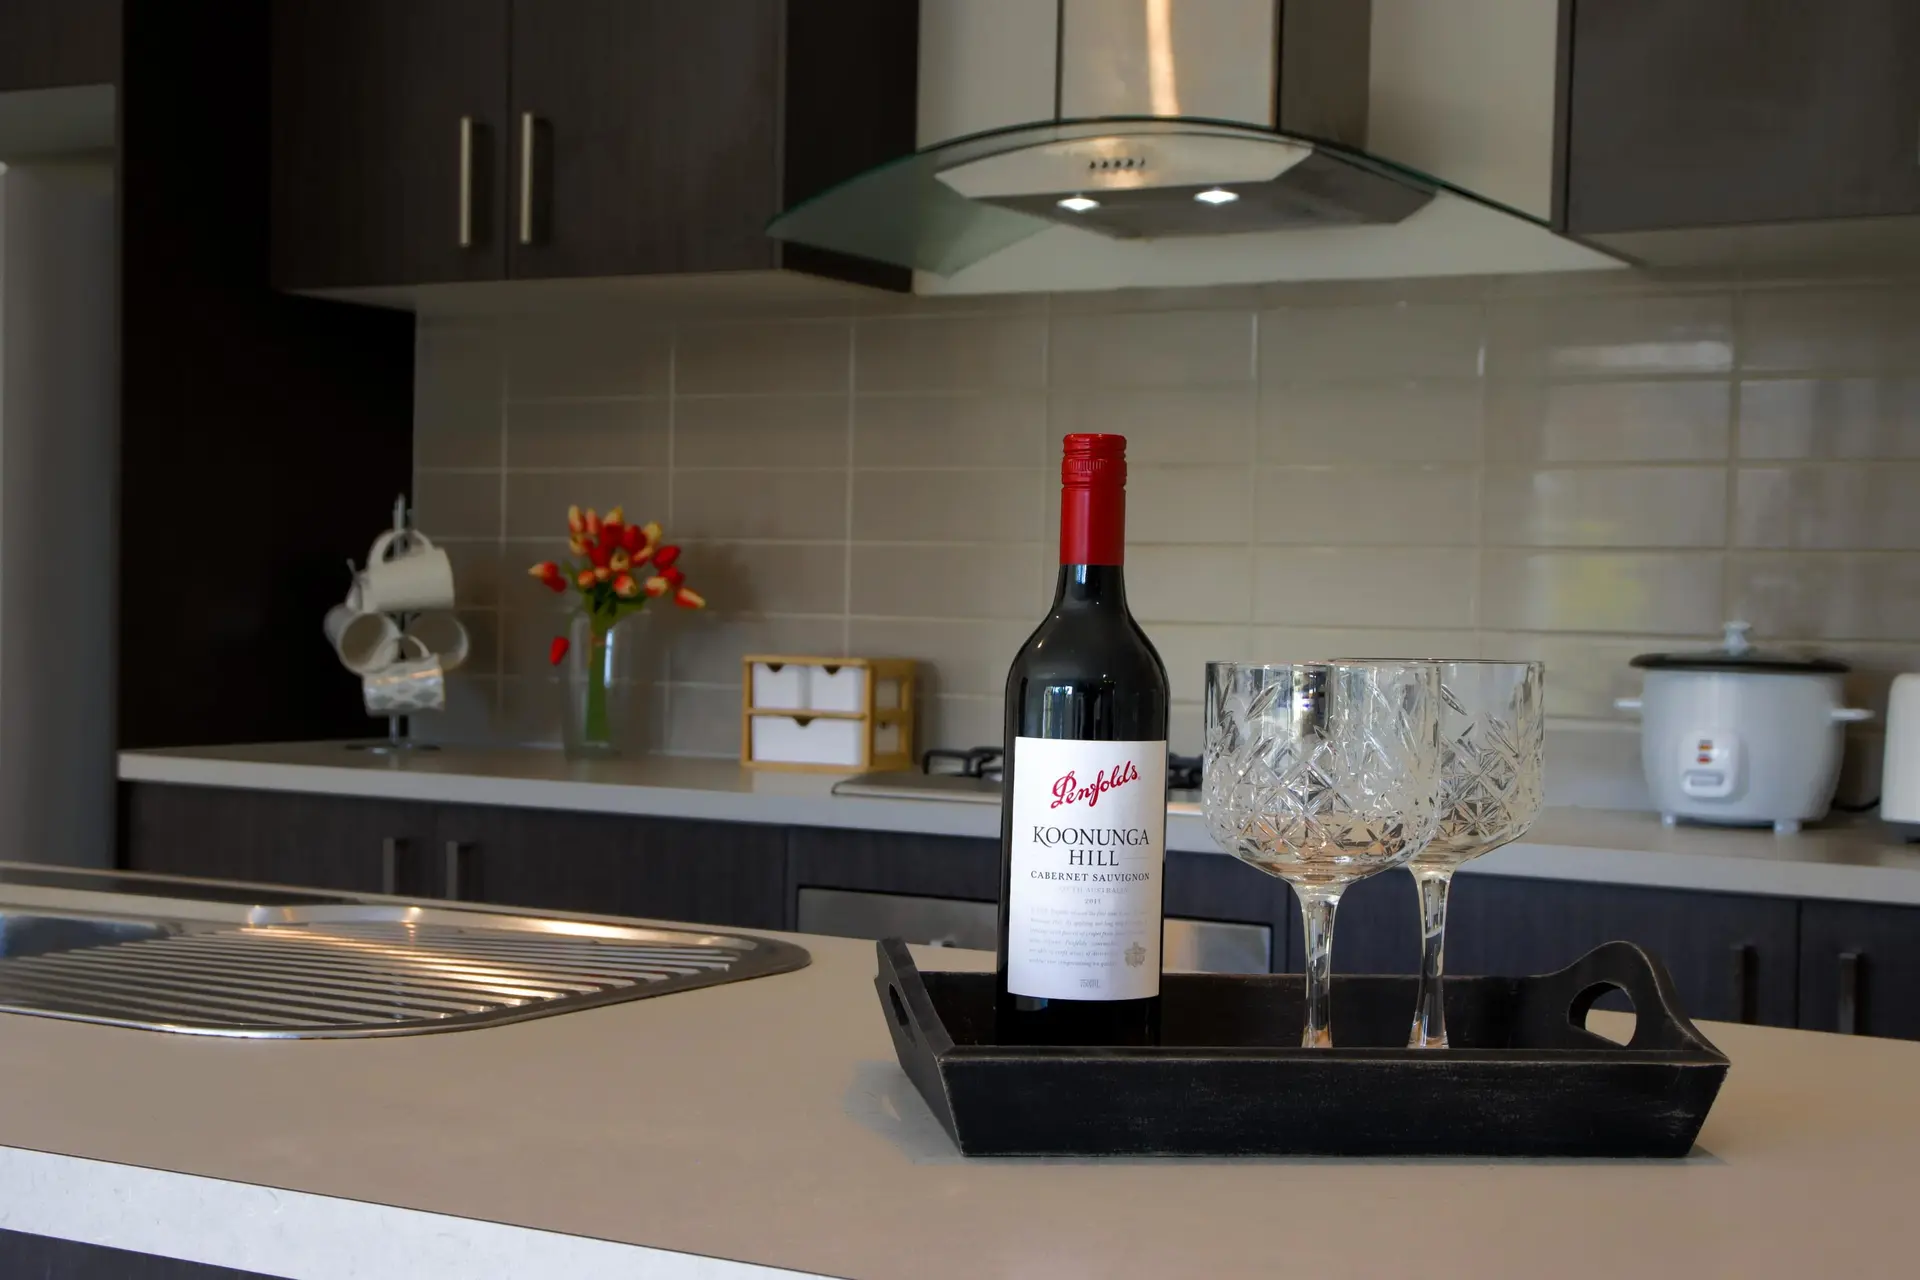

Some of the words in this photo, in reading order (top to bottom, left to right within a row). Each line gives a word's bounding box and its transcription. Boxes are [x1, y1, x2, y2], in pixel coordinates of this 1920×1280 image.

[1050, 760, 1139, 809] Penfolds
[1032, 826, 1150, 848] KOONUNGA
[1068, 849, 1120, 866] HILL
[1030, 870, 1089, 882] CABERNET
[1092, 872, 1150, 882] SAUVIGNON
